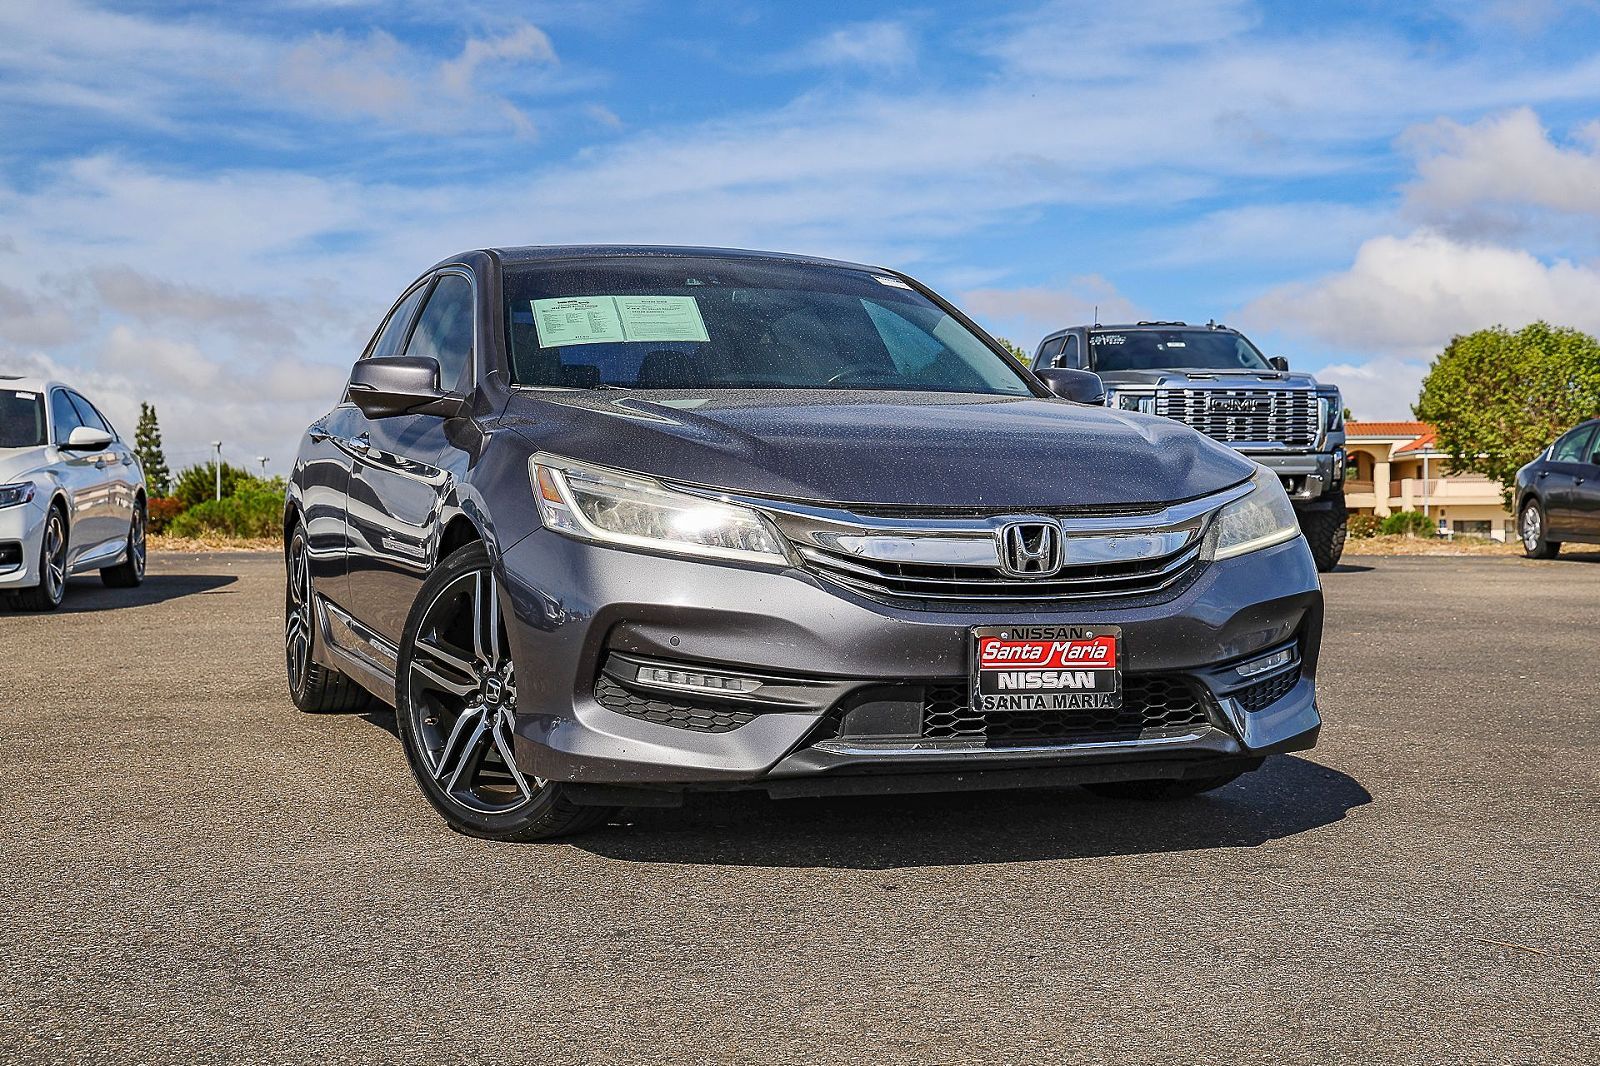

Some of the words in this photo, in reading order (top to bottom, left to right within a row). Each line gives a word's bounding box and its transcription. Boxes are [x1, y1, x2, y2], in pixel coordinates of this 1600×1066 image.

[1011, 627, 1083, 640] NISSAN
[982, 641, 1043, 660] Santa
[1045, 641, 1108, 663] Maria
[997, 671, 1096, 690] NISSAN
[984, 694, 1047, 710] SANTA
[1052, 693, 1113, 709] MARIA
